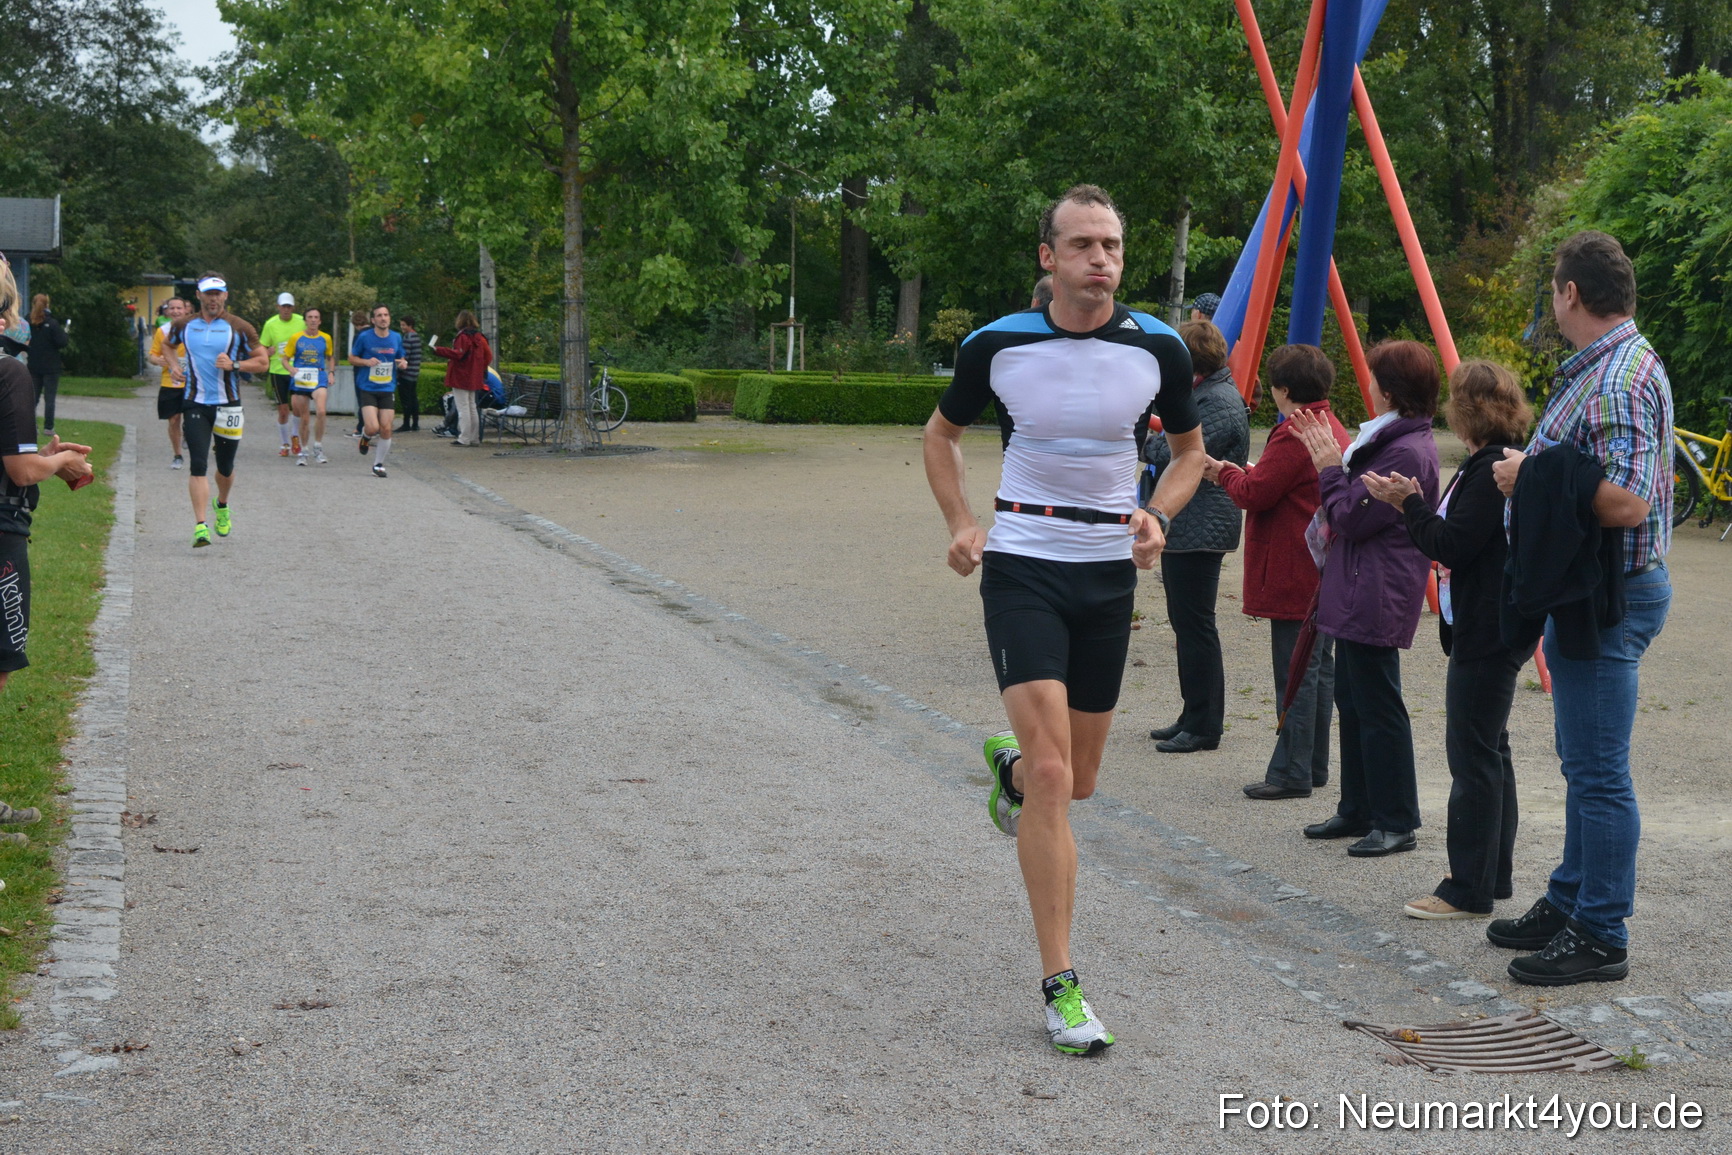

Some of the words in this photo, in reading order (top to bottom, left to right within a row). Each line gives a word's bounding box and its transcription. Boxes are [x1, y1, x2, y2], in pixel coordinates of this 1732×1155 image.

[375, 367, 389, 376] 621
[301, 373, 311, 381] 40
[226, 415, 240, 428] 80
